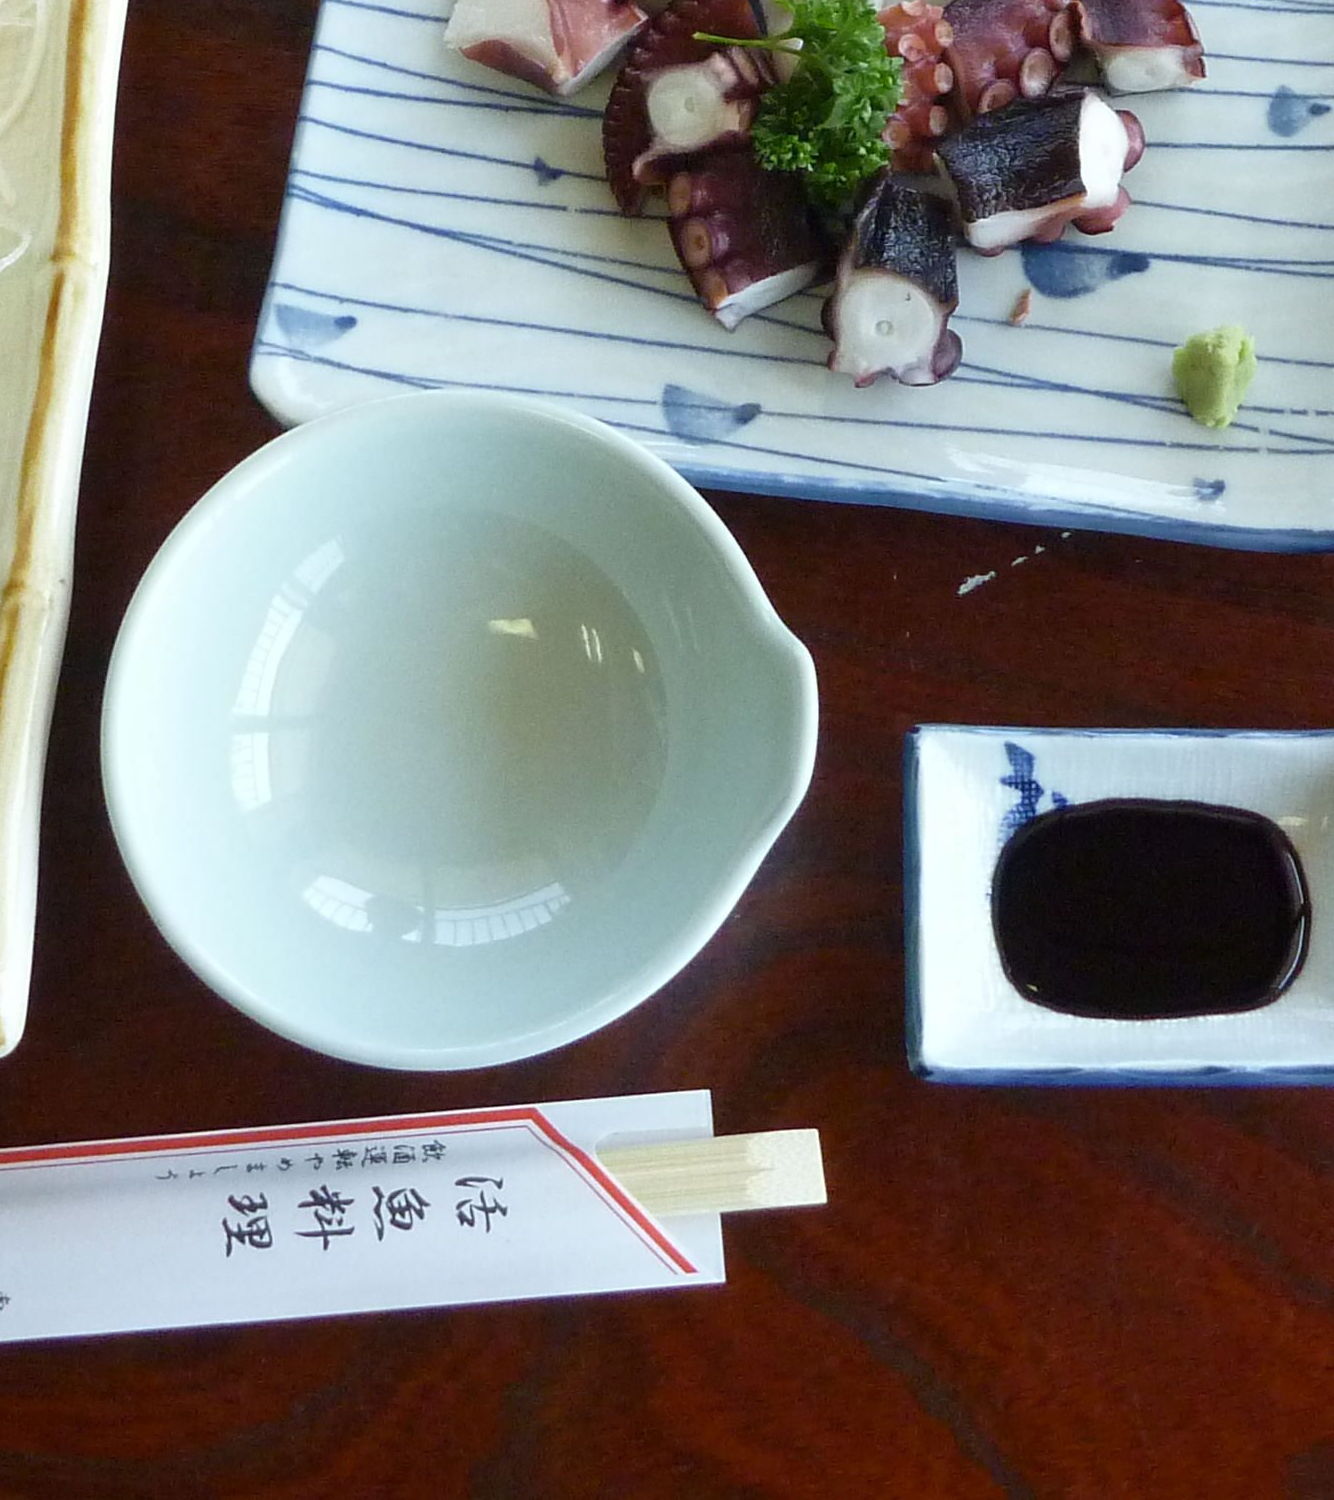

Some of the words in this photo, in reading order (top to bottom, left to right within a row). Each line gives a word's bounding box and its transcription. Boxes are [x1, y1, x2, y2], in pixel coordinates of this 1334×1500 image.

[156, 1139, 447, 1181] 飲酒運転やめましょう
[225, 1175, 509, 1258] 活魚料理
